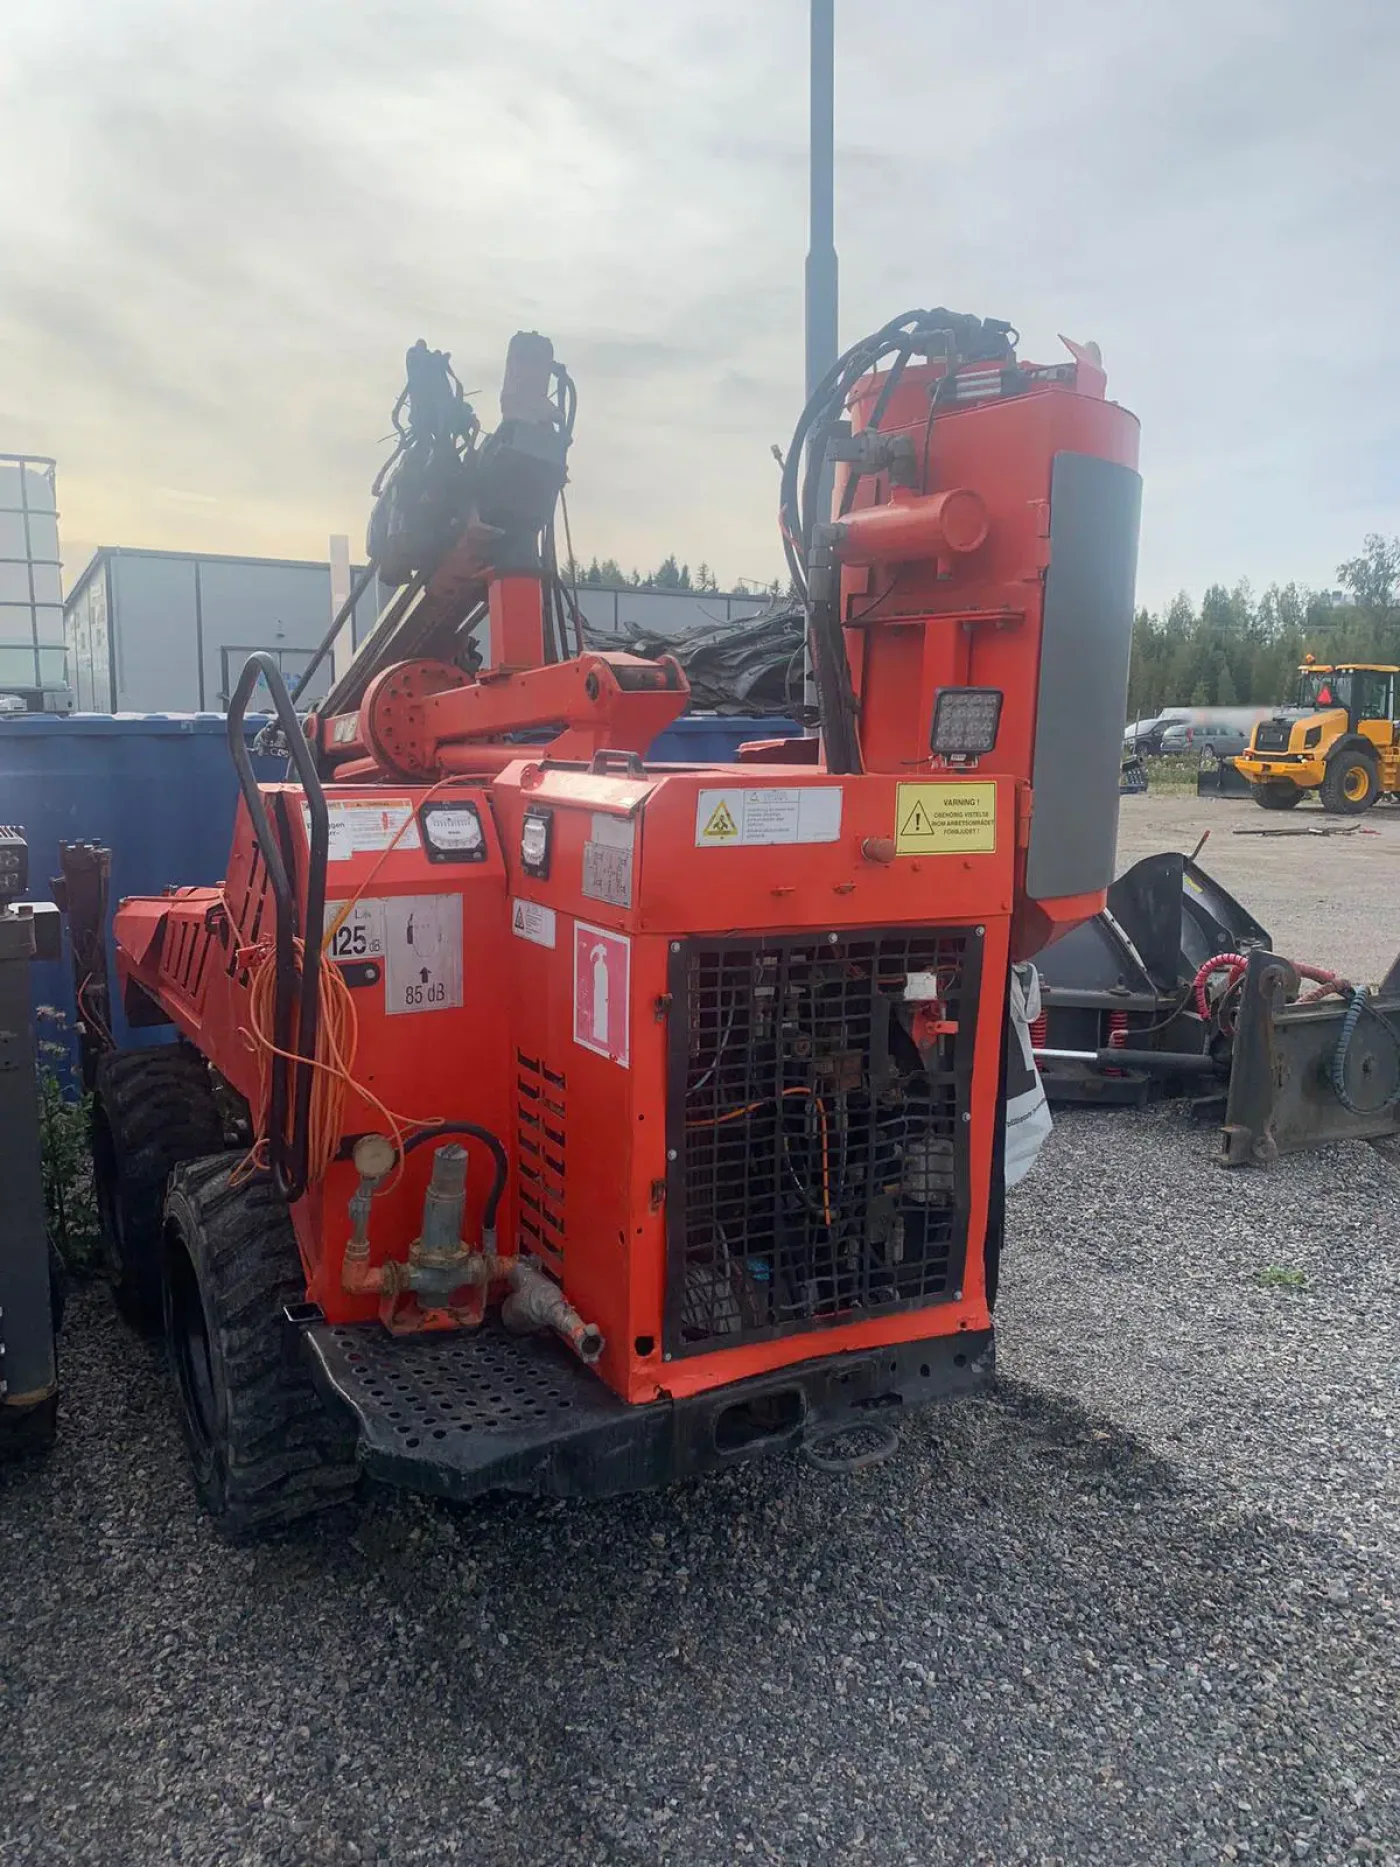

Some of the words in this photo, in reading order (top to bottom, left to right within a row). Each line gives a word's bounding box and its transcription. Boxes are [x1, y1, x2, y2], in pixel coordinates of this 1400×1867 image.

[943, 798, 975, 806] VARNING
[332, 925, 367, 956] 125
[405, 985, 423, 1005] 85
[427, 982, 445, 1002] dB
